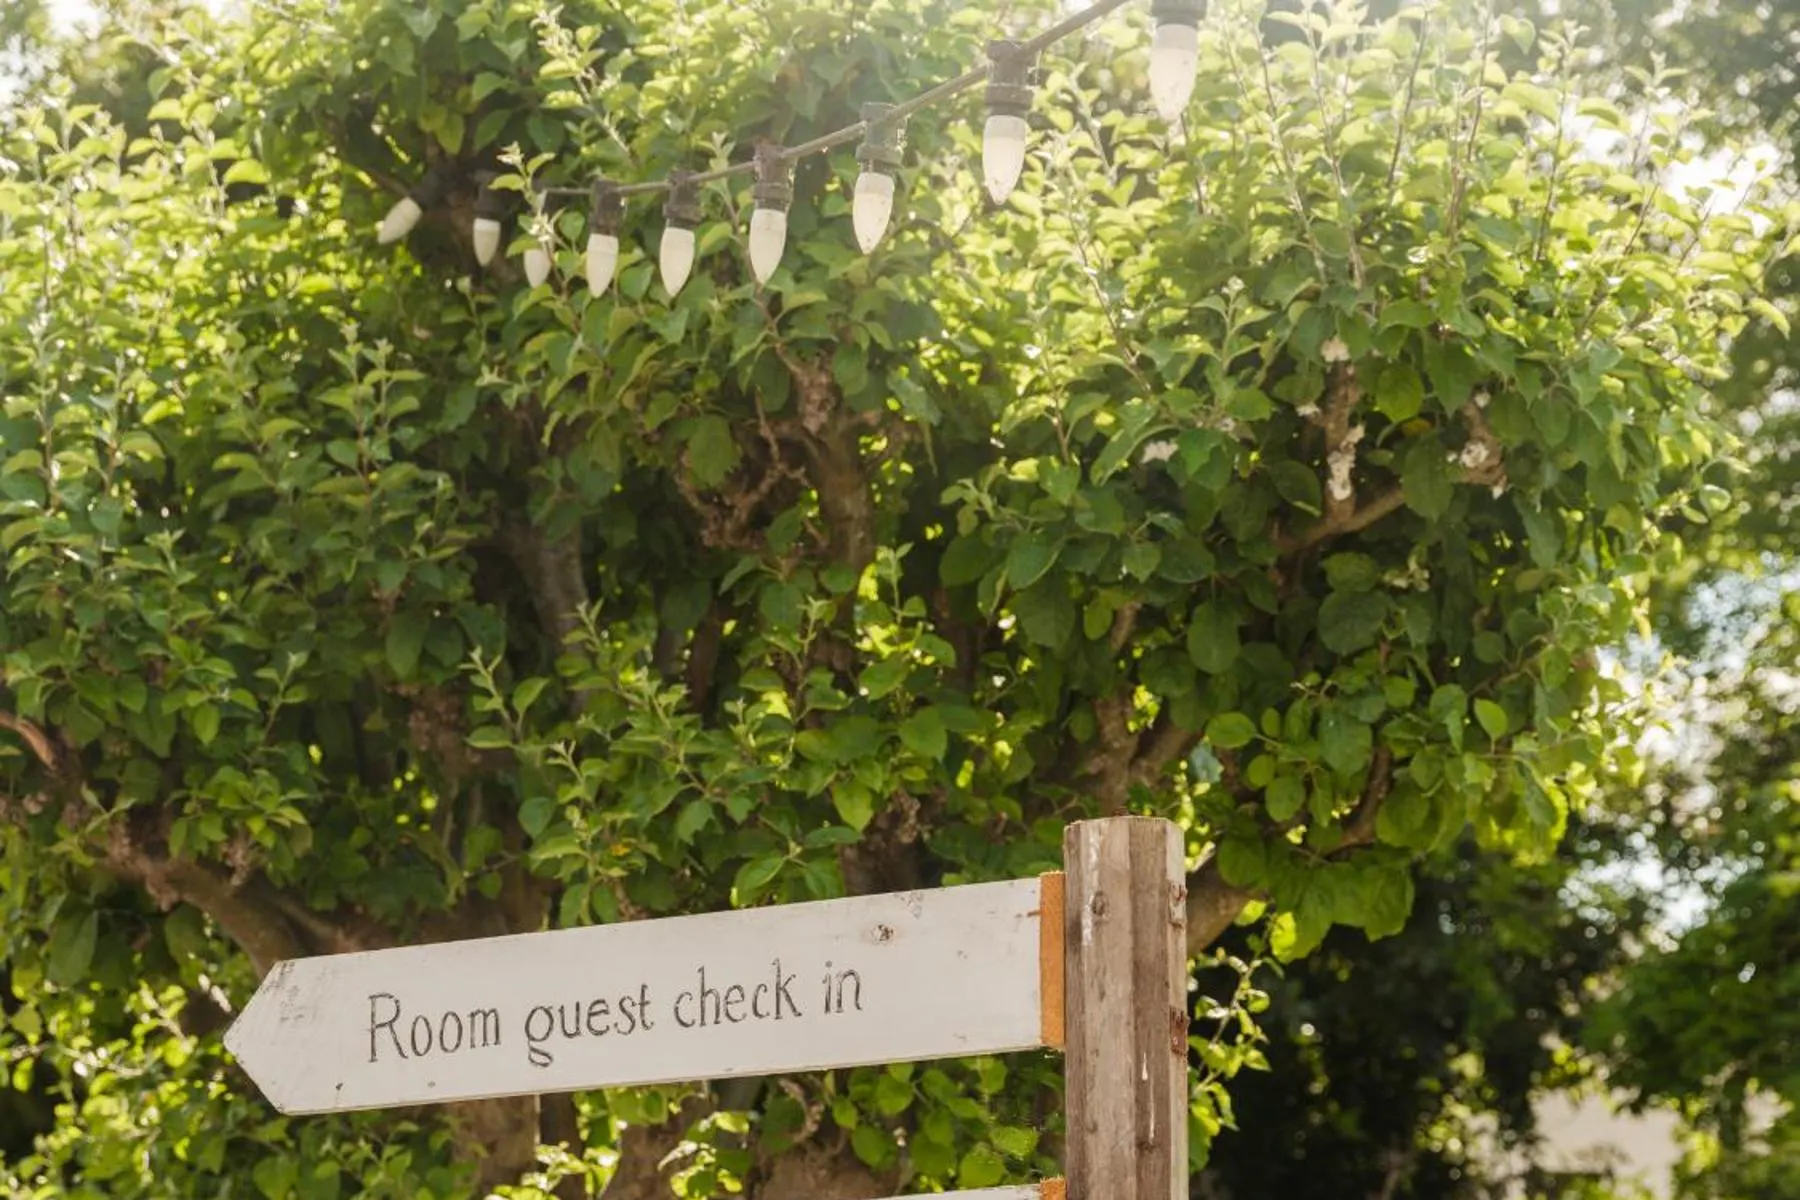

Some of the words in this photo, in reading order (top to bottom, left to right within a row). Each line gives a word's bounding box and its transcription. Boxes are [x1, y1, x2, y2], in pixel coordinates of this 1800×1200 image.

[367, 991, 502, 1063] Room
[523, 982, 656, 1068] guest
[672, 958, 803, 1028] check
[822, 960, 864, 1014] in
